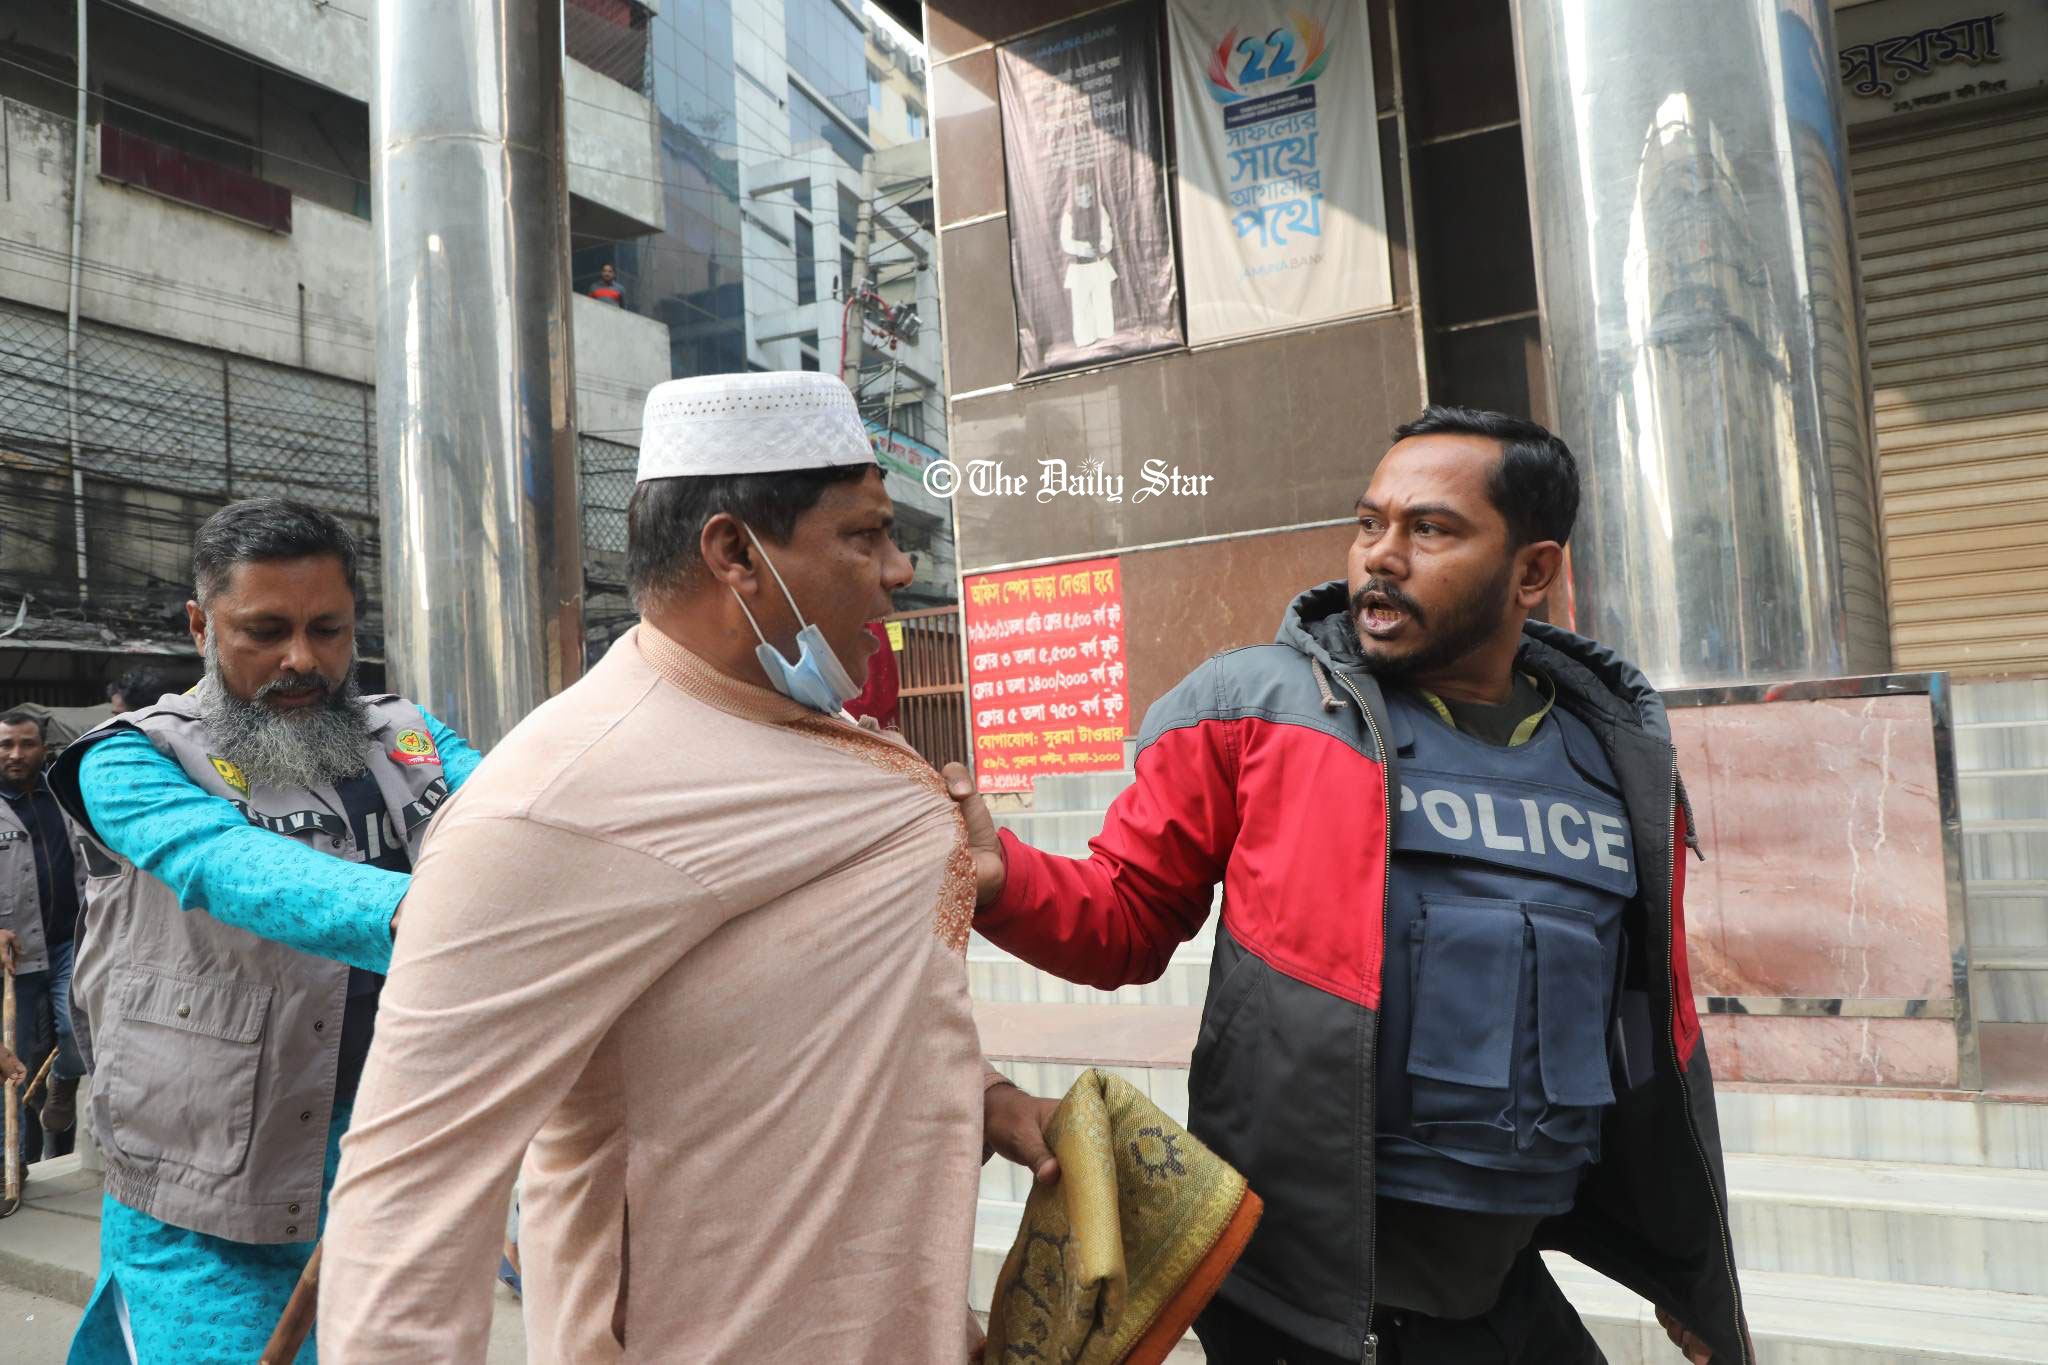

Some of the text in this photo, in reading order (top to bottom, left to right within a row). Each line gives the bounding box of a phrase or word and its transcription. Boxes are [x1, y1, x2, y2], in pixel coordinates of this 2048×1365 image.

[1236, 27, 1296, 85] 22
[1224, 112, 1316, 146] সাফল্যের
[1227, 131, 1318, 182] সাথে
[1230, 168, 1320, 206] আগামীর
[1232, 192, 1325, 248] পথে
[1033, 576, 1056, 603] ভাড়া
[1060, 572, 1091, 598] দেওয়া
[1093, 569, 1115, 596] হবে
[974, 653, 998, 672] ফ্লোর
[1013, 649, 1036, 666] তলা
[1040, 647, 1077, 666] ৫,৫০০
[1079, 634, 1098, 658] বর্গ
[1101, 635, 1119, 660] ফুট
[973, 682, 994, 700] ফ্লোর
[1006, 678, 1025, 694] তলা
[1090, 662, 1106, 685] বর্গ
[1108, 662, 1124, 687] ফুট
[978, 693, 1124, 728] ফ্লোর ৫ তলা ৭৫০ বর্গ ফুট
[1043, 729, 1075, 749] সুরমা
